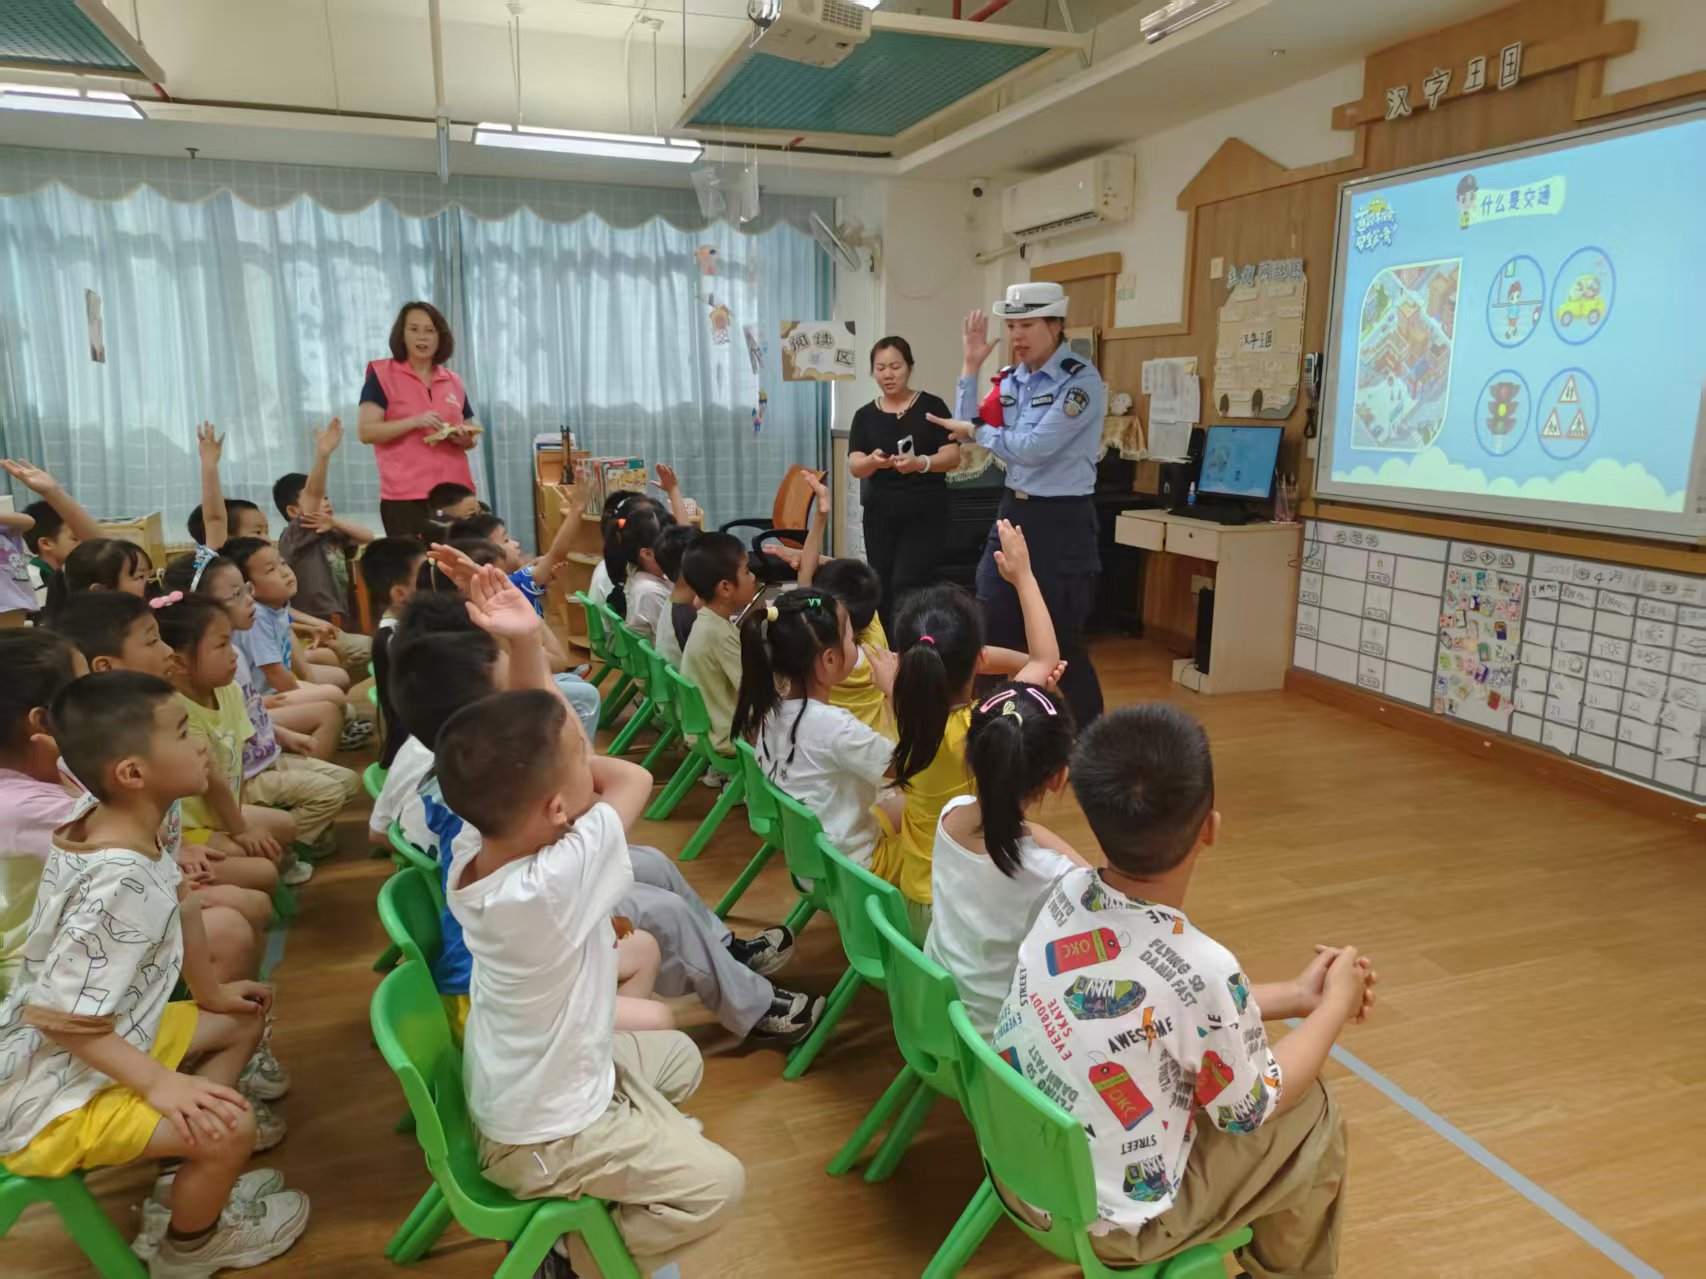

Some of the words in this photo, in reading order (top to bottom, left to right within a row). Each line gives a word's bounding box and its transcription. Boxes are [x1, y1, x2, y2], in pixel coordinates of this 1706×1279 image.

[1386, 44, 1520, 119] 汉字王国
[1481, 184, 1551, 216] 什么是交通
[791, 331, 852, 366] 阅读区
[1061, 939, 1090, 959] OKC
[1149, 938, 1192, 975] FLYING
[1189, 974, 1206, 993] SO
[1019, 967, 1029, 1007] STREET
[1139, 950, 1178, 982] DAMN
[1170, 979, 1198, 1008] FAST
[1029, 991, 1073, 1061] EVERYBODY
[1047, 998, 1073, 1038] SKATE
[1107, 1016, 1174, 1054] AWESOME
[1026, 1061, 1038, 1080] SO
[1028, 1044, 1049, 1073] FAST
[1045, 1069, 1079, 1103] DAMN
[1109, 1088, 1137, 1117] OKC
[1120, 1134, 1158, 1156] STREET
